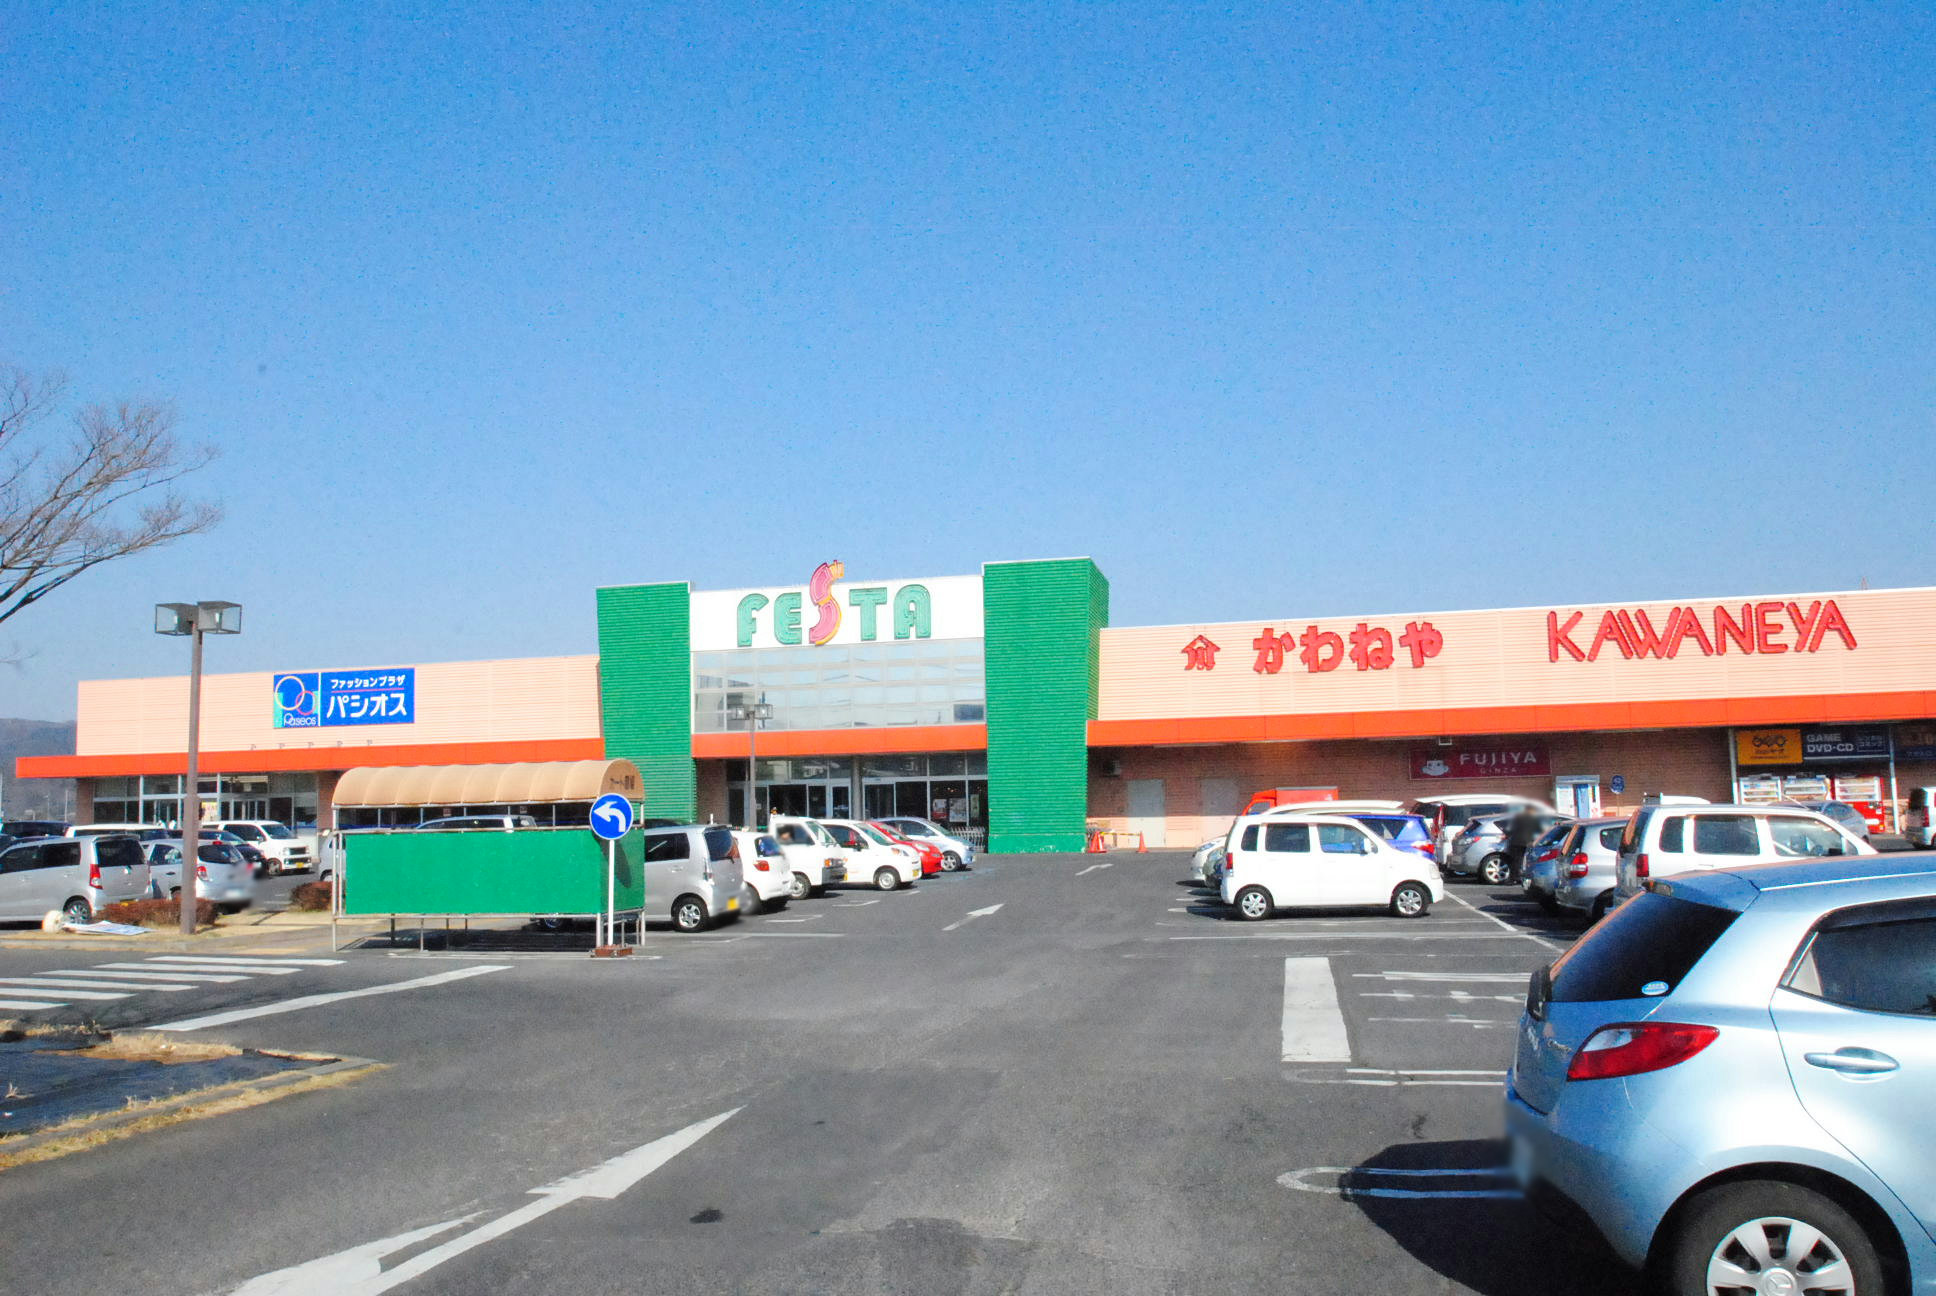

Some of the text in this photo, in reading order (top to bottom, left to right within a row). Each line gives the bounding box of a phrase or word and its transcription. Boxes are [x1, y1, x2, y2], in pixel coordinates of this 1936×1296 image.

[737, 559, 932, 647] FESTA
[1547, 600, 1858, 662] KAWANEYA
[1253, 622, 1443, 674] かわねや
[331, 675, 406, 688] ファッションプラザ
[327, 693, 407, 718] パシオス
[284, 713, 317, 726] Paseos
[1807, 733, 1841, 743] GAME
[1460, 752, 1537, 766] FUJIYA
